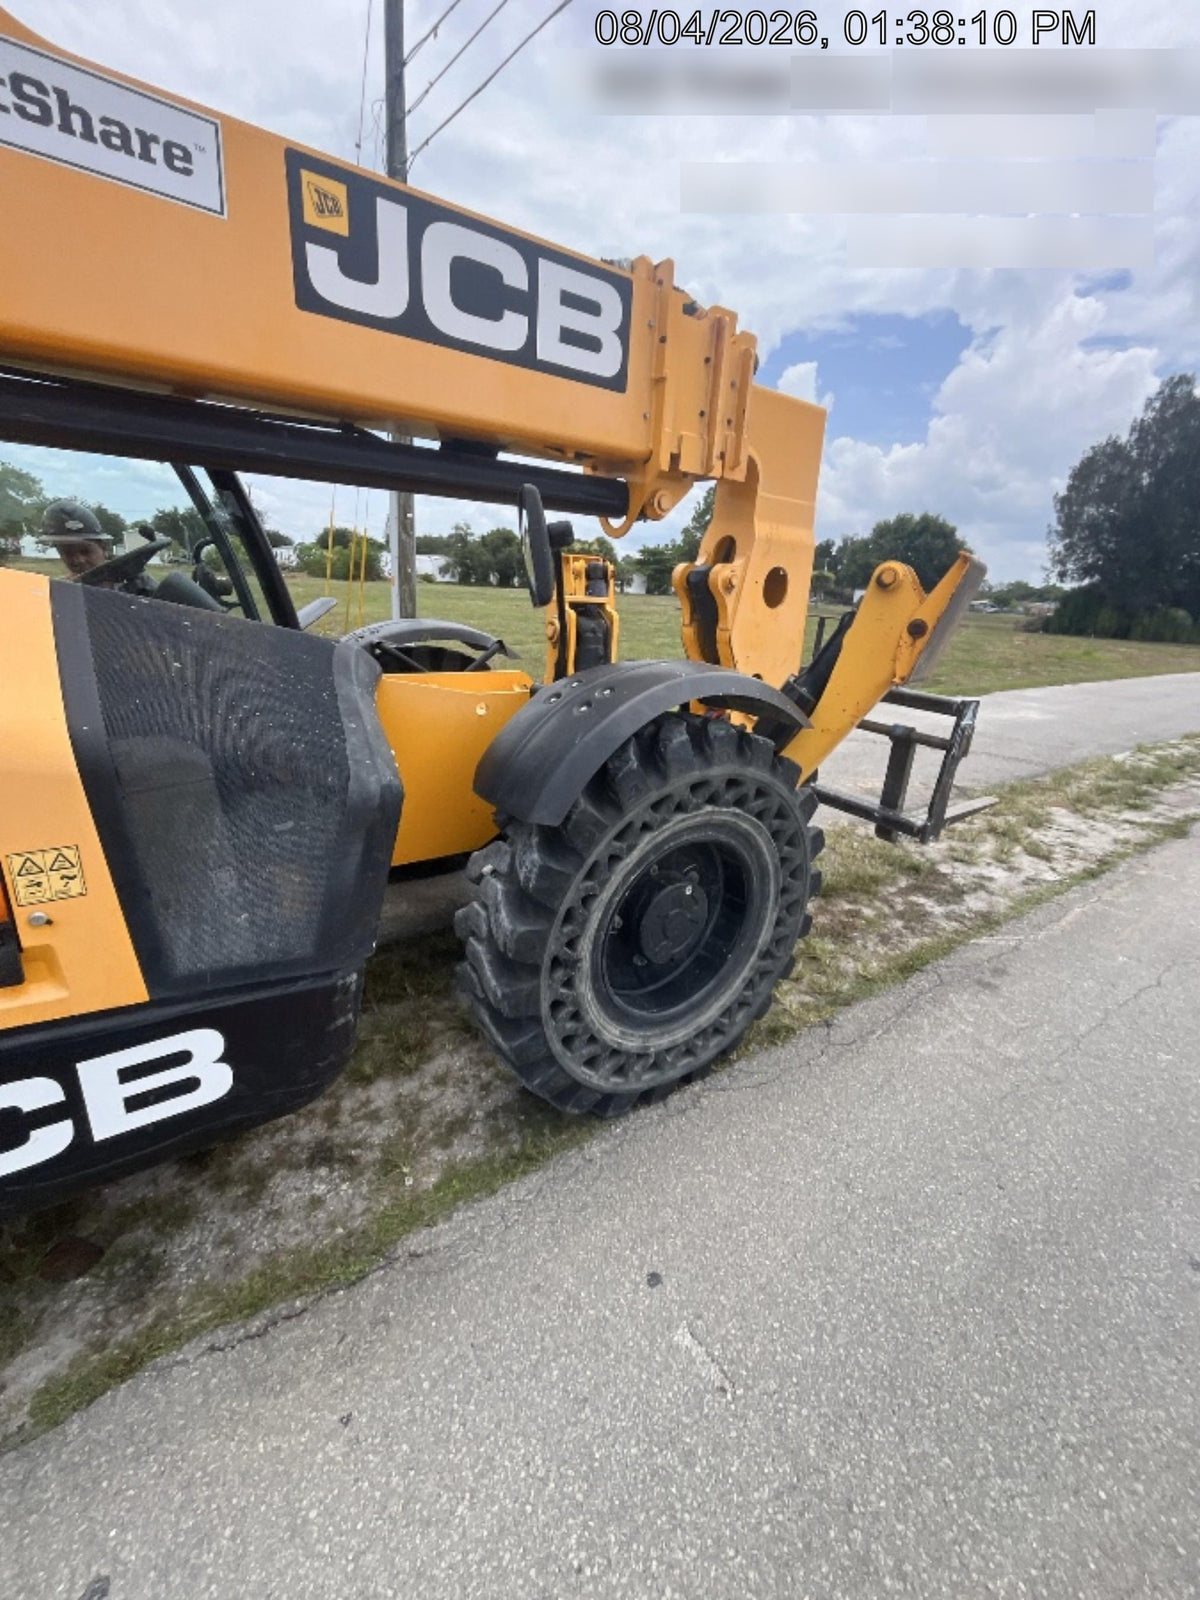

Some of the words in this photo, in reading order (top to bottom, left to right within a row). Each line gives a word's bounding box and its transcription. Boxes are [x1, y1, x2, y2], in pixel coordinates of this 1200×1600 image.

[0, 71, 194, 177] Share
[314, 187, 341, 214] JCB
[304, 197, 624, 379] JCB
